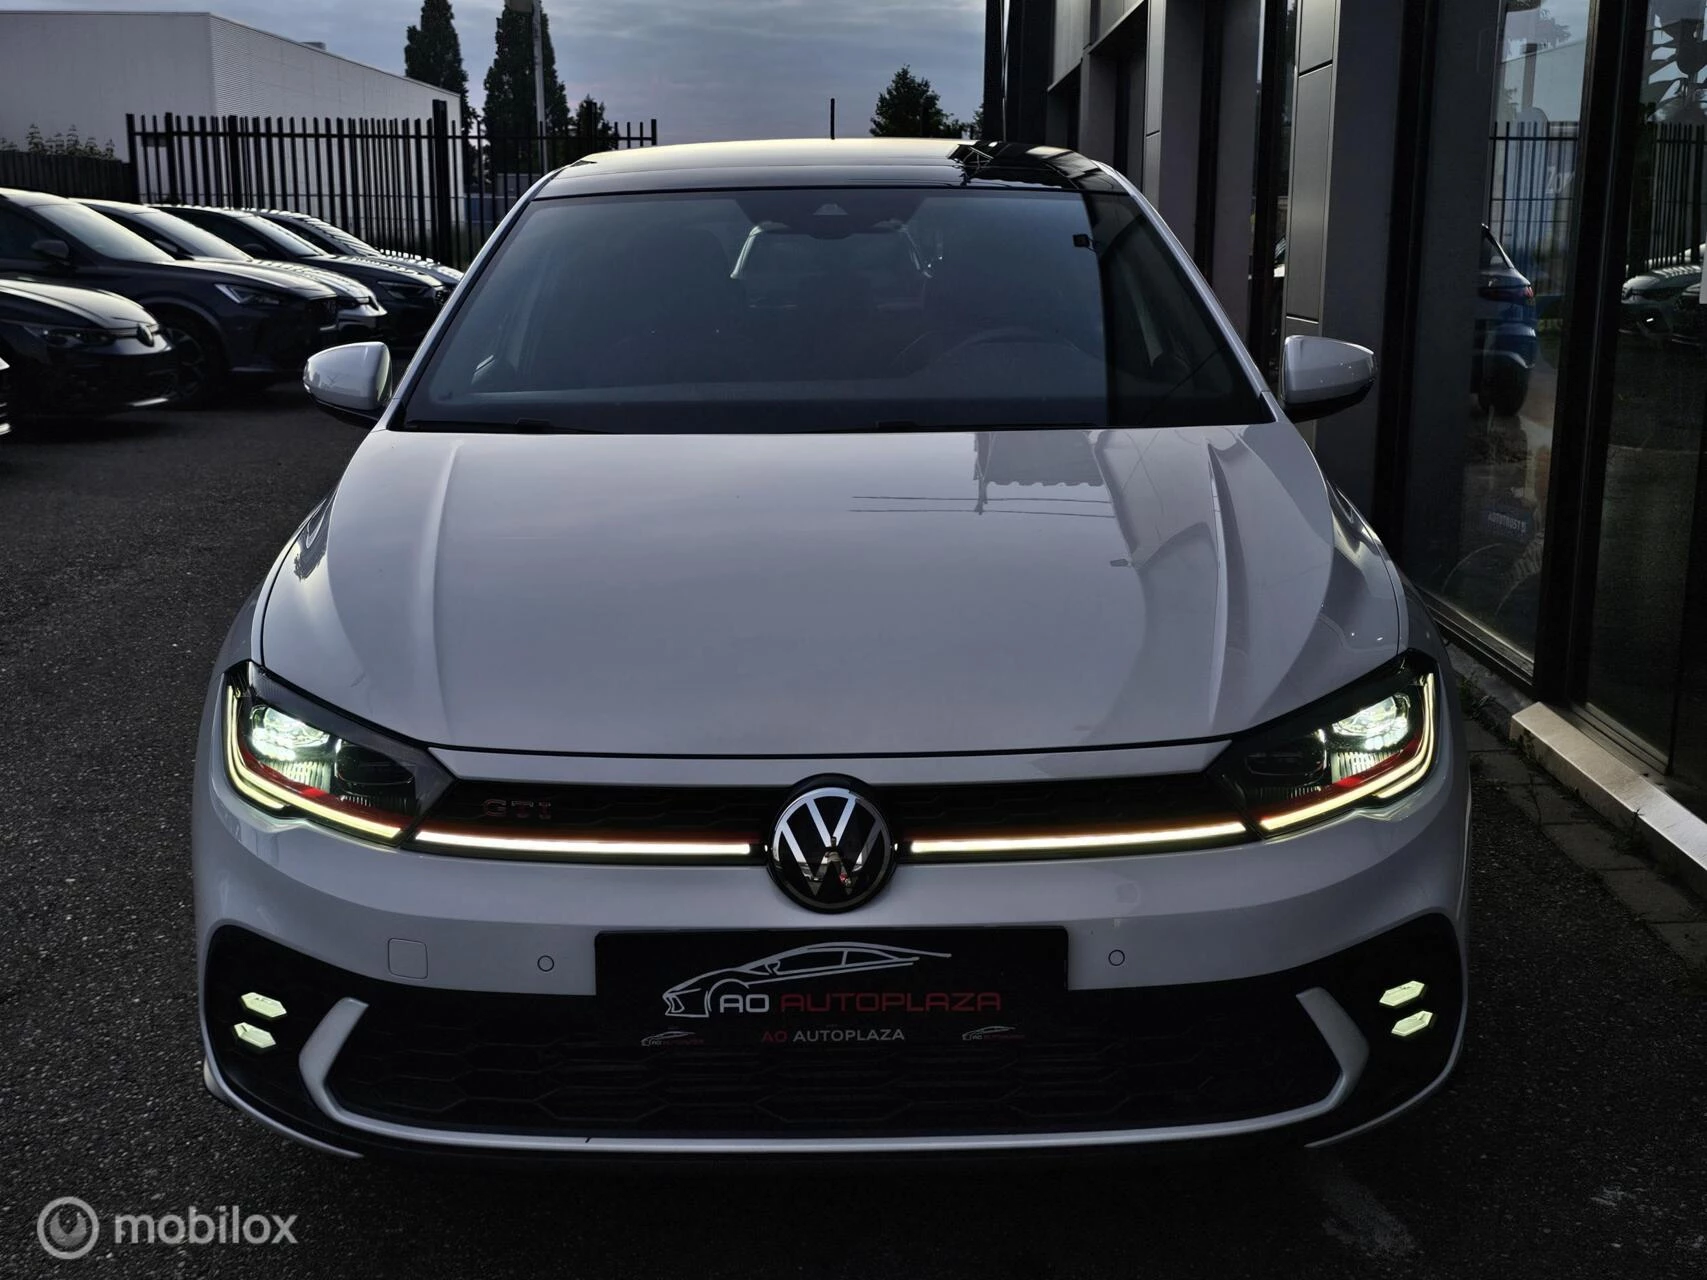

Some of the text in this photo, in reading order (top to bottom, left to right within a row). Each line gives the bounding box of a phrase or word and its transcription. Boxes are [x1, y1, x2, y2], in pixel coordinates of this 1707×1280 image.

[482, 798, 552, 819] GTI
[719, 992, 1002, 1013] AO AUTOPLAZA
[792, 1028, 905, 1043] AUTOPLAZA
